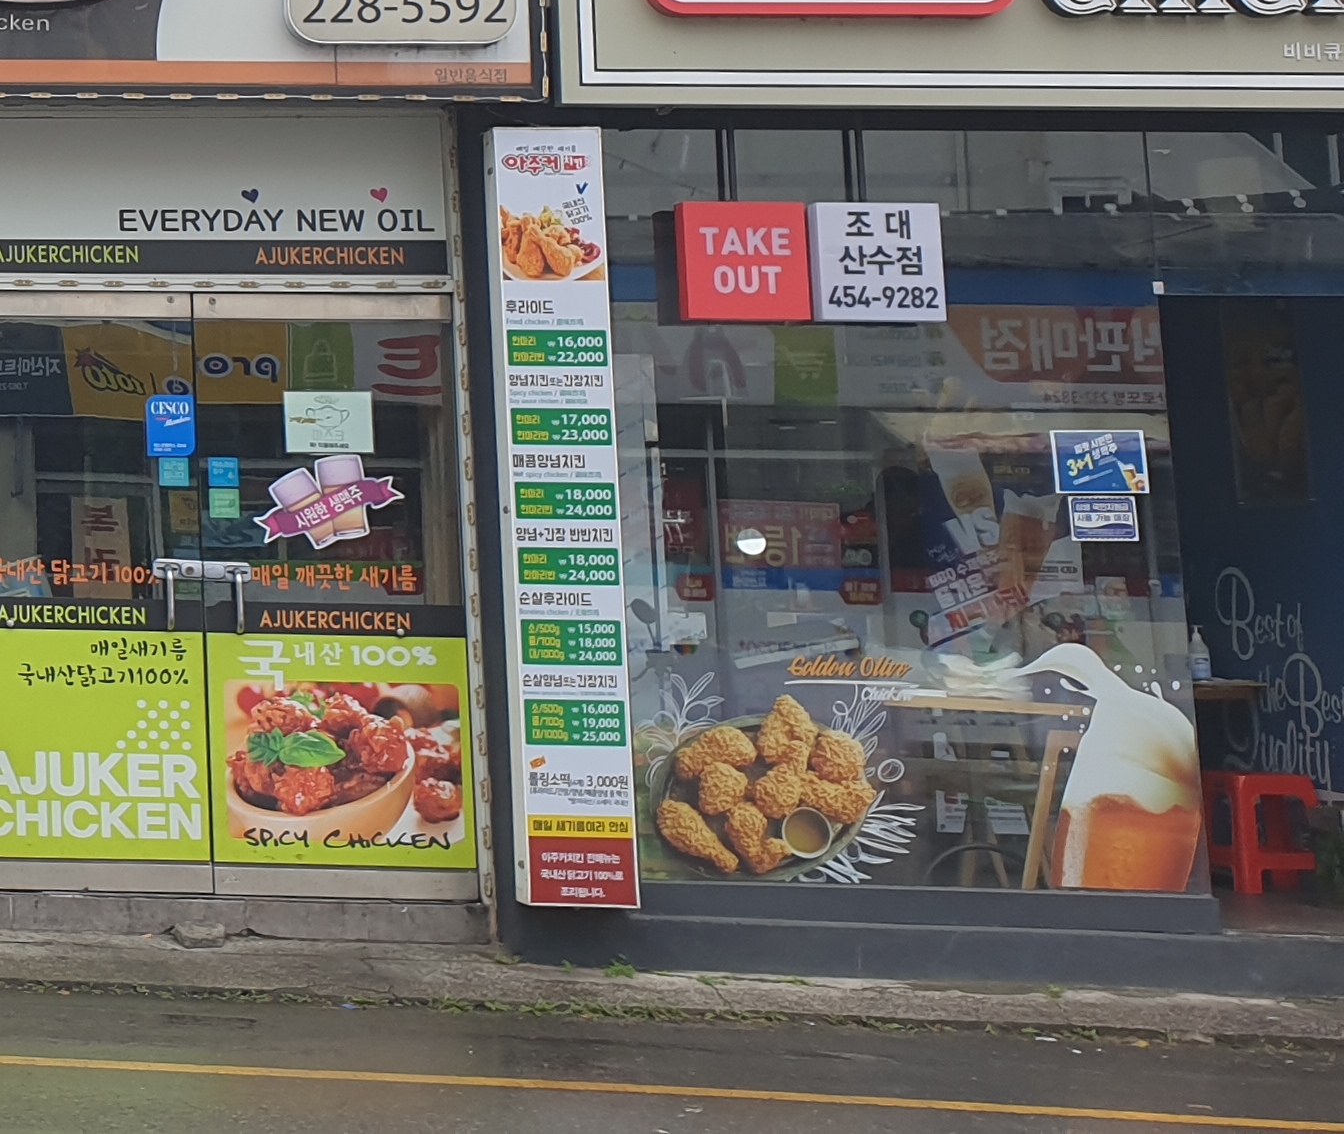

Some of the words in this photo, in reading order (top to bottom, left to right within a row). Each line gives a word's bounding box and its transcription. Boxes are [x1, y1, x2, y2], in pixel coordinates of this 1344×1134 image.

[434, 68, 507, 84] 일반음식점
[502, 154, 560, 176] 아주커
[118, 208, 285, 235] EVERYDAY
[296, 208, 365, 233] NEW
[377, 207, 435, 233] OIL
[570, 215, 592, 226] 100%
[699, 227, 792, 255] TAKE
[255, 245, 405, 267] AJUKERCHICKEN
[839, 245, 923, 276] 산수점
[714, 266, 782, 294] OUT
[506, 300, 554, 315] 후라이드
[829, 285, 939, 309] 454-9282
[150, 402, 189, 415] CESCO
[512, 454, 586, 468] 매콤양념치킨
[295, 504, 330, 529] 시원한
[329, 485, 363, 512] 생맥주
[516, 527, 566, 541] 양념+간장
[569, 528, 613, 542] 반반치킨
[51, 558, 107, 586] 닭고기
[113, 565, 161, 586] 100%
[251, 564, 289, 587] 매일
[296, 564, 352, 590] 깨끗한
[359, 565, 417, 592] 새기름
[519, 592, 592, 606] 순살후라이드
[260, 610, 411, 630] AJUKERCHICKEN
[90, 638, 188, 662] 매일새기름
[238, 640, 343, 692] 국내산
[350, 644, 438, 667] 100%
[787, 654, 856, 678] Golden
[859, 656, 912, 678] Olive
[586, 774, 628, 790] 3,000원
[609, 822, 629, 833] 안심
